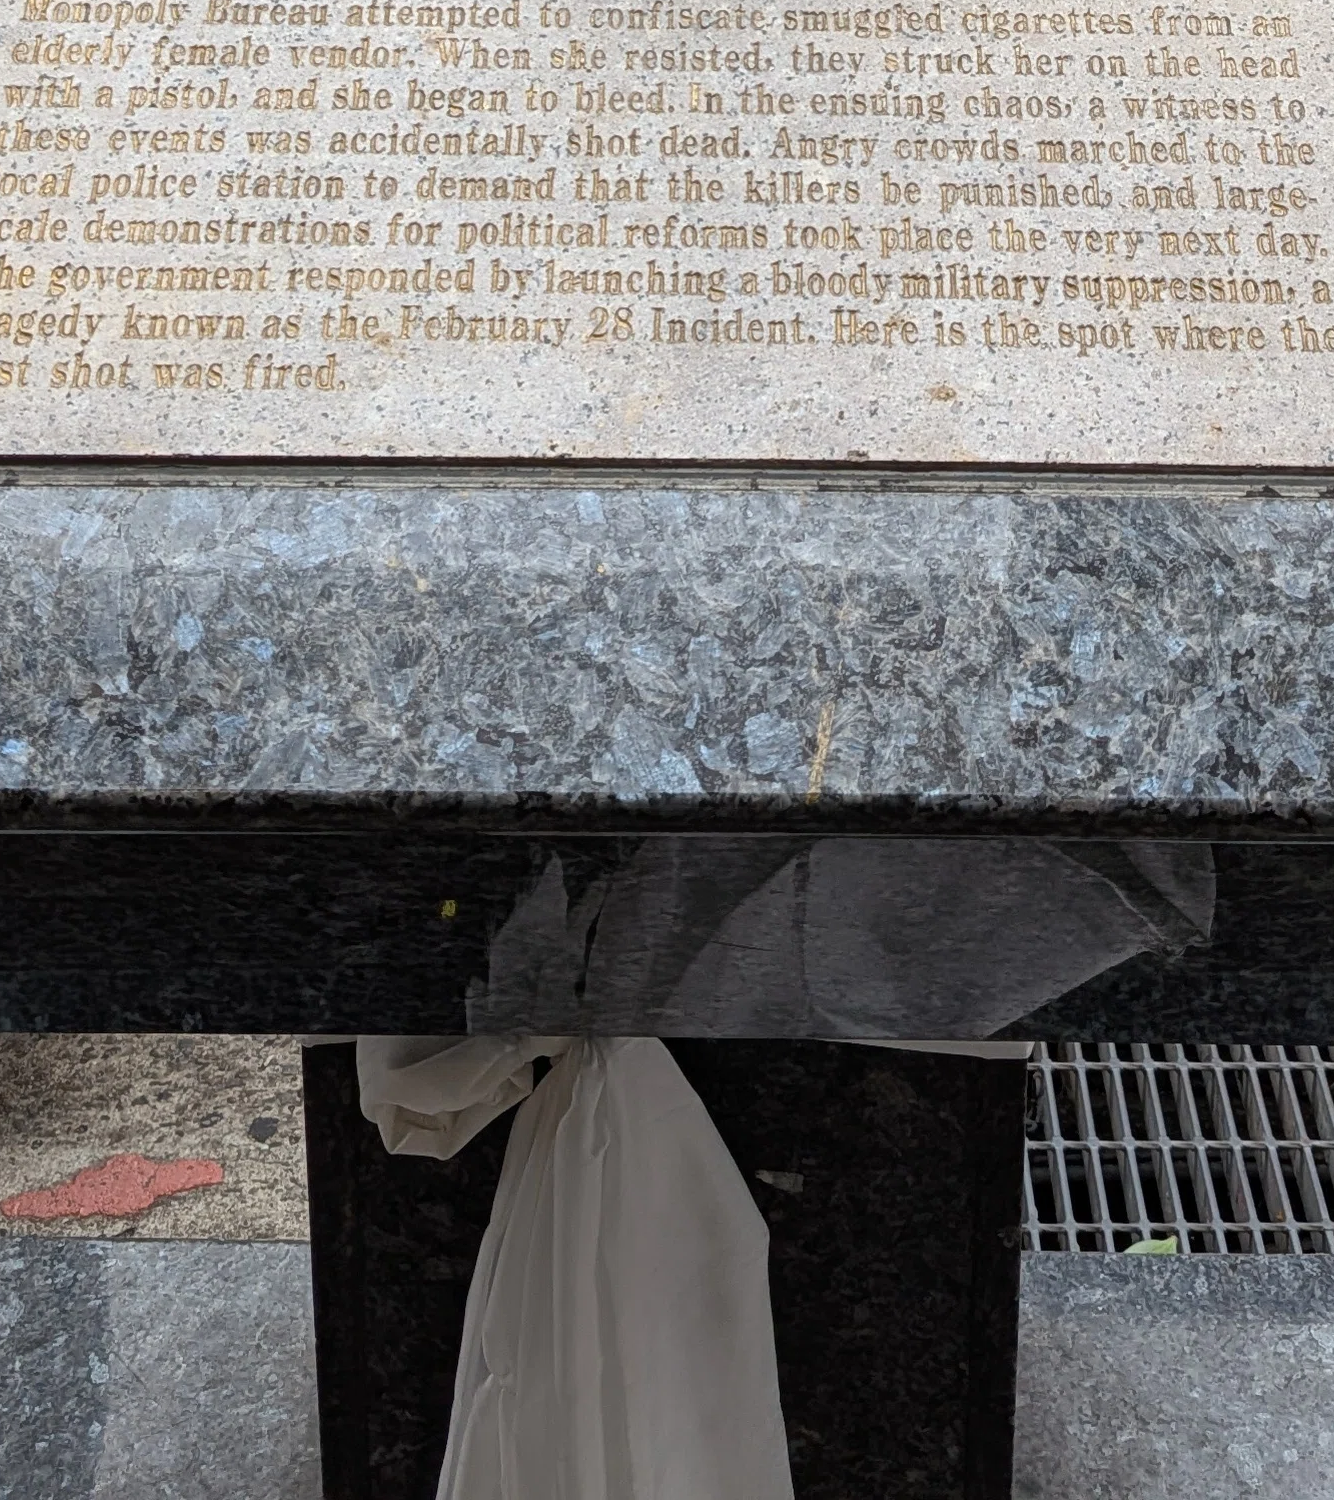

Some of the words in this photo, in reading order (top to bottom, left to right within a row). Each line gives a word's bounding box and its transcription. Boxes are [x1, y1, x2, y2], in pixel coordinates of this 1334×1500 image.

[7, 32, 136, 73] elderly
[149, 34, 272, 67] female
[287, 35, 420, 68] vendor.
[432, 37, 532, 69] When
[549, 38, 608, 70] she
[624, 40, 774, 76] resisted,
[791, 42, 865, 81] they
[884, 43, 997, 75] struck
[1013, 45, 1070, 76] her
[1086, 55, 1129, 76] on
[1144, 46, 1202, 77] the
[1216, 46, 1301, 78] head
[1, 77, 85, 108] with
[92, 87, 114, 109] a
[123, 77, 240, 117] pistol,
[251, 78, 320, 110] and
[331, 79, 393, 111] she
[405, 80, 511, 120] began
[523, 84, 559, 113] to
[573, 82, 677, 114] bleed.
[689, 83, 725, 115] In
[738, 84, 798, 115] the
[810, 85, 946, 124] ensuing
[962, 86, 1076, 122] chaos,
[1086, 97, 1108, 118] a
[1121, 88, 1257, 119] witness
[1268, 92, 1307, 120] to
[87, 165, 201, 206] police
[215, 166, 349, 199] station
[362, 170, 399, 200] to
[415, 168, 557, 202] demand
[573, 170, 648, 203] that
[667, 171, 724, 204] the
[743, 172, 861, 205] killers
[880, 174, 923, 206] be
[937, 175, 1114, 215] punished,
[1129, 176, 1197, 209] and
[1211, 177, 1321, 217] large-
[46, 258, 274, 299] government
[284, 257, 476, 301] responded
[489, 259, 530, 302] by
[543, 260, 725, 304] launching
[741, 273, 760, 297] a
[770, 262, 887, 306] bloody
[901, 264, 1050, 308] military
[1060, 265, 1299, 310] suppression,
[1309, 278, 1334, 302] a
[120, 303, 250, 339] known
[260, 315, 303, 340] as
[319, 304, 384, 341] the
[395, 305, 573, 351] February
[587, 307, 634, 343] 28
[649, 308, 817, 345] Incident.
[832, 310, 920, 346] Here
[934, 311, 966, 347] is
[982, 312, 1041, 348] the
[1057, 316, 1138, 357] spot
[1151, 313, 1268, 350] where
[47, 352, 134, 389] shot
[149, 364, 225, 390] was
[241, 353, 352, 391] fired.
